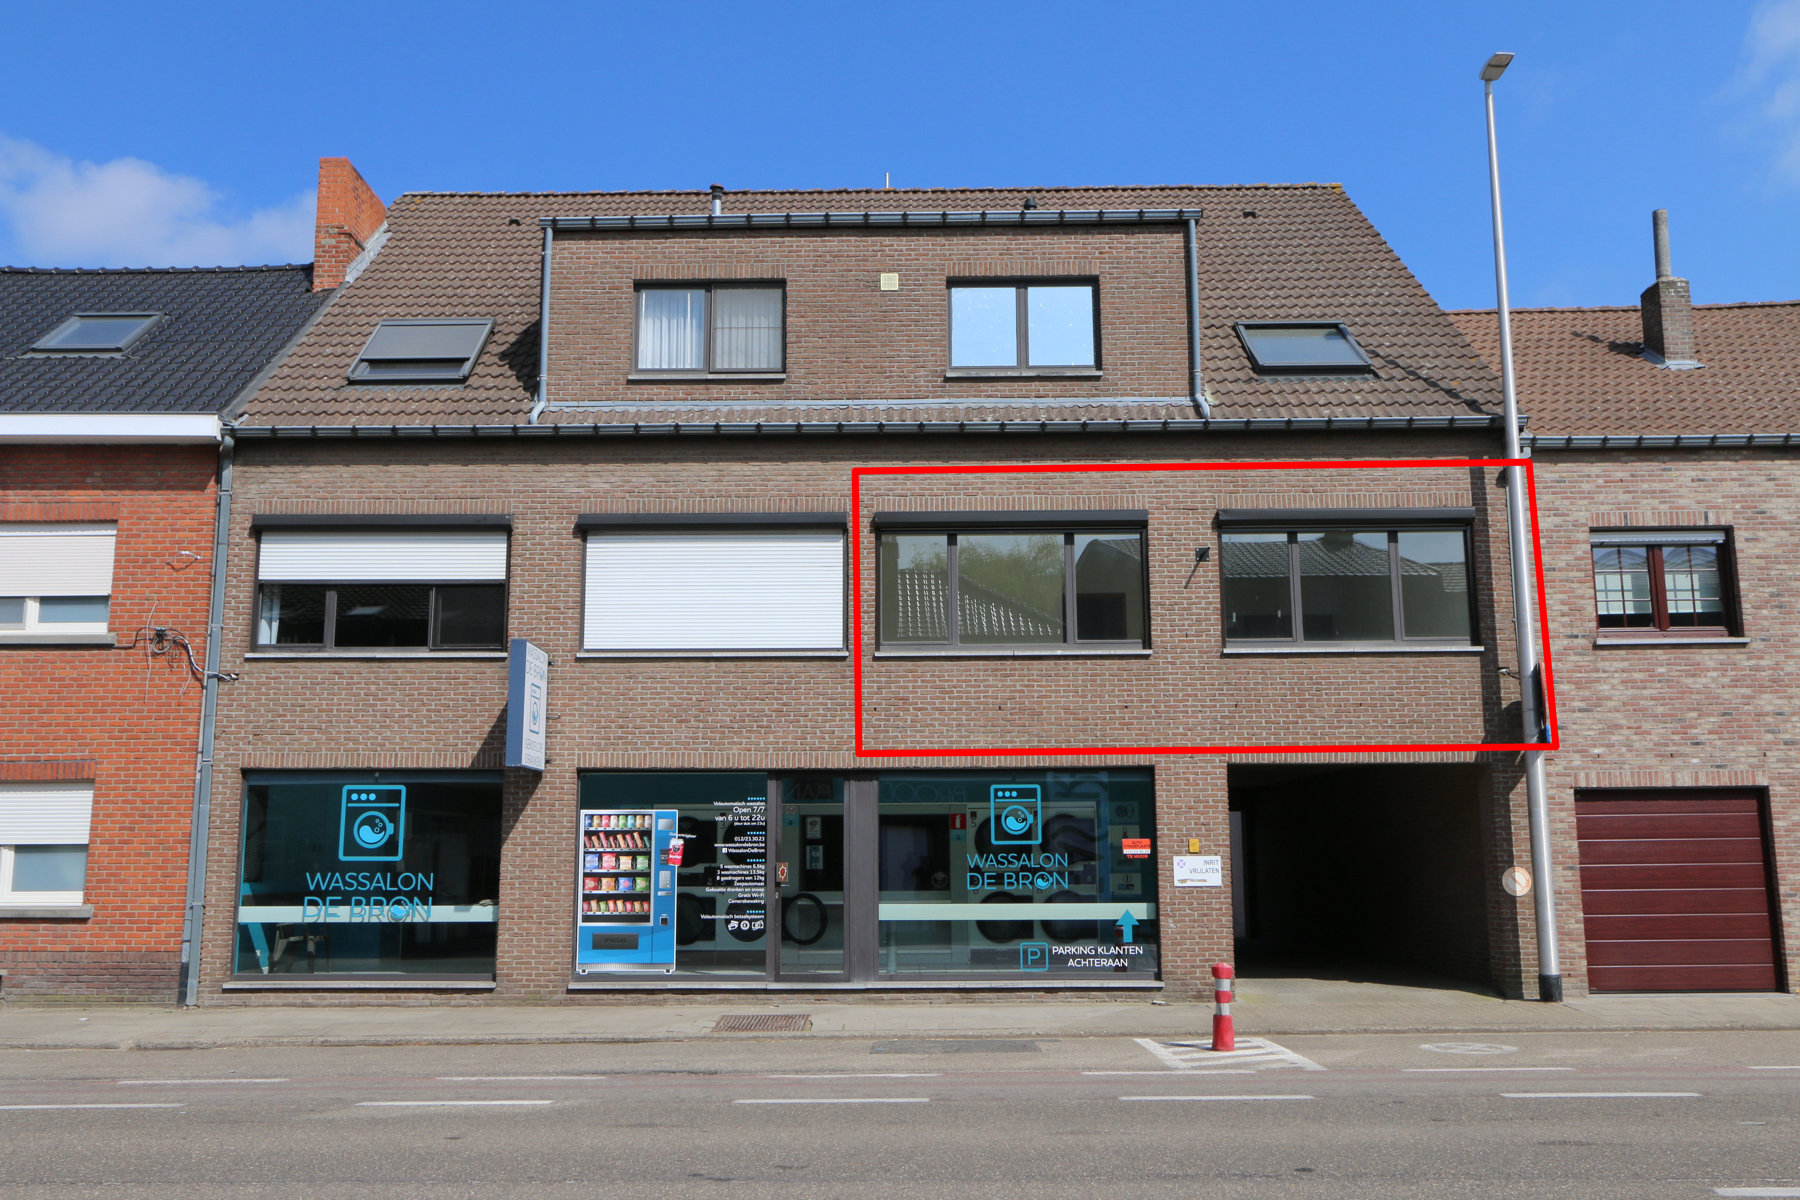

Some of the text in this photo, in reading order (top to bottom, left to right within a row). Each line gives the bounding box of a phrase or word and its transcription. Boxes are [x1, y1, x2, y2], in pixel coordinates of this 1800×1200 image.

[733, 806, 752, 814] Open
[966, 853, 1068, 868] WASSALON
[306, 872, 434, 891] WASSALON
[966, 871, 1069, 890] DE BRON
[303, 895, 433, 919] DE BRON
[1027, 945, 1143, 966] P PARKING KLANTEN
[1067, 958, 1128, 967] ACHTERAAN
